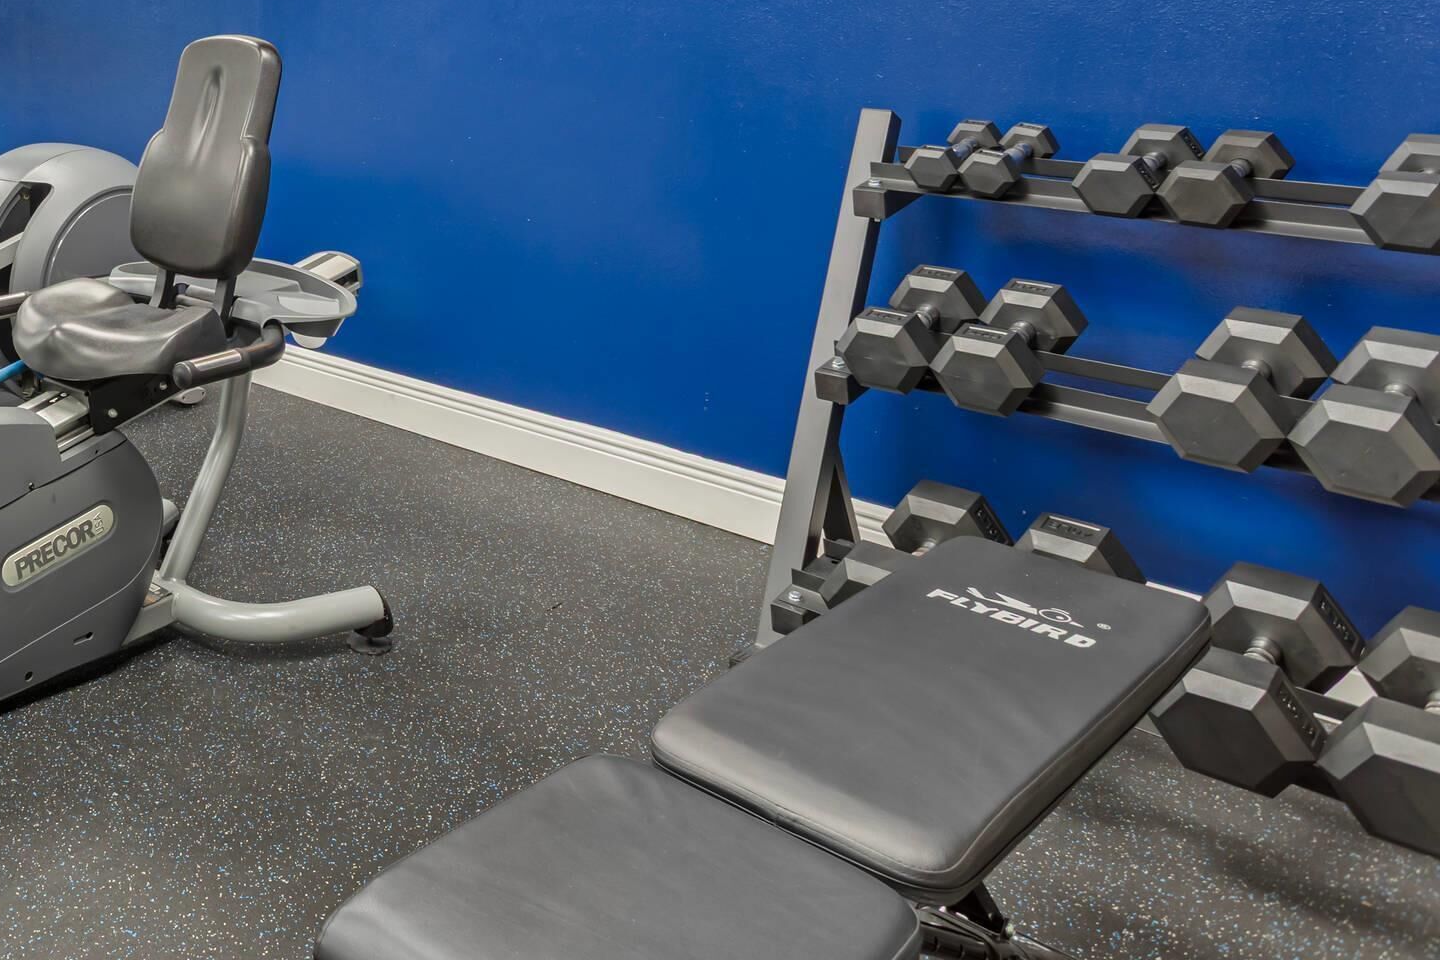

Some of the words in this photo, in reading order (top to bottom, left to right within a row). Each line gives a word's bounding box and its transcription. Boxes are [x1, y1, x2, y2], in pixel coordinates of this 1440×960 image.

[14, 519, 95, 580] PRECOR
[93, 512, 105, 536] USA
[926, 588, 1097, 648] FLYBIRD
